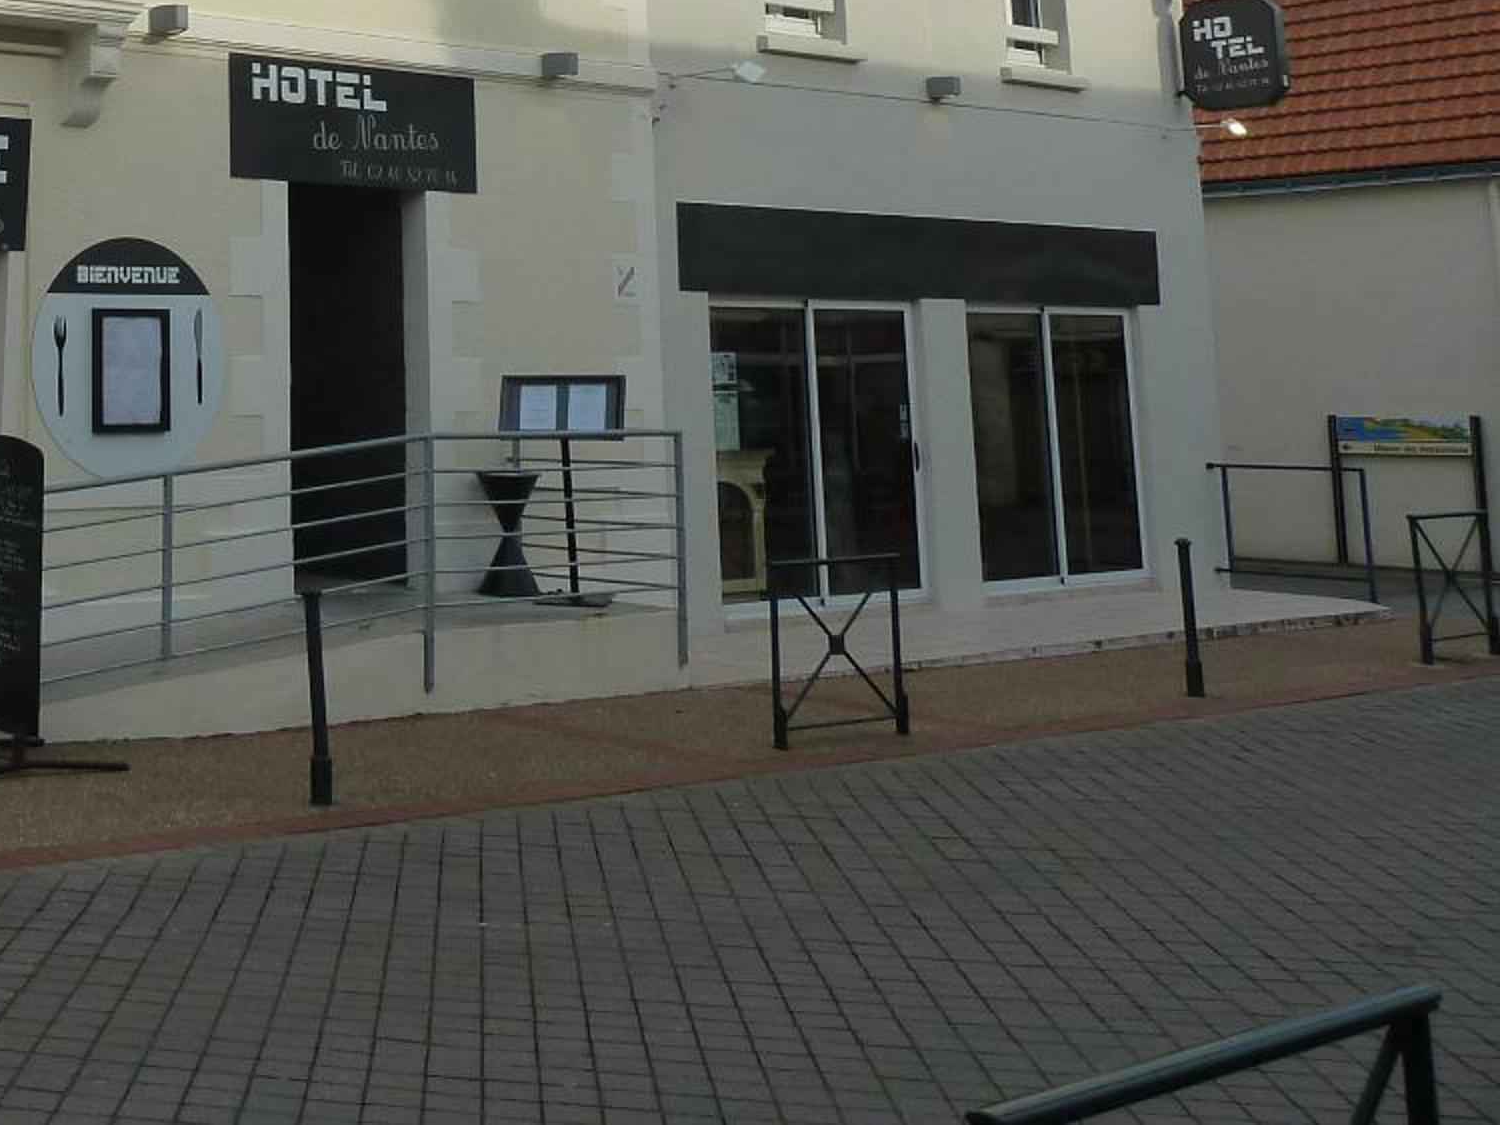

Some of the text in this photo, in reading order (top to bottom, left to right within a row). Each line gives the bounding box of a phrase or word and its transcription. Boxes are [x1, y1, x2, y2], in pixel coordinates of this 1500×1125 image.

[1192, 16, 1232, 41] HO
[1211, 36, 1264, 59] TEL
[251, 62, 388, 112] HOTEL
[313, 114, 439, 151] de Nantes
[77, 265, 180, 284] BIENVENUE
